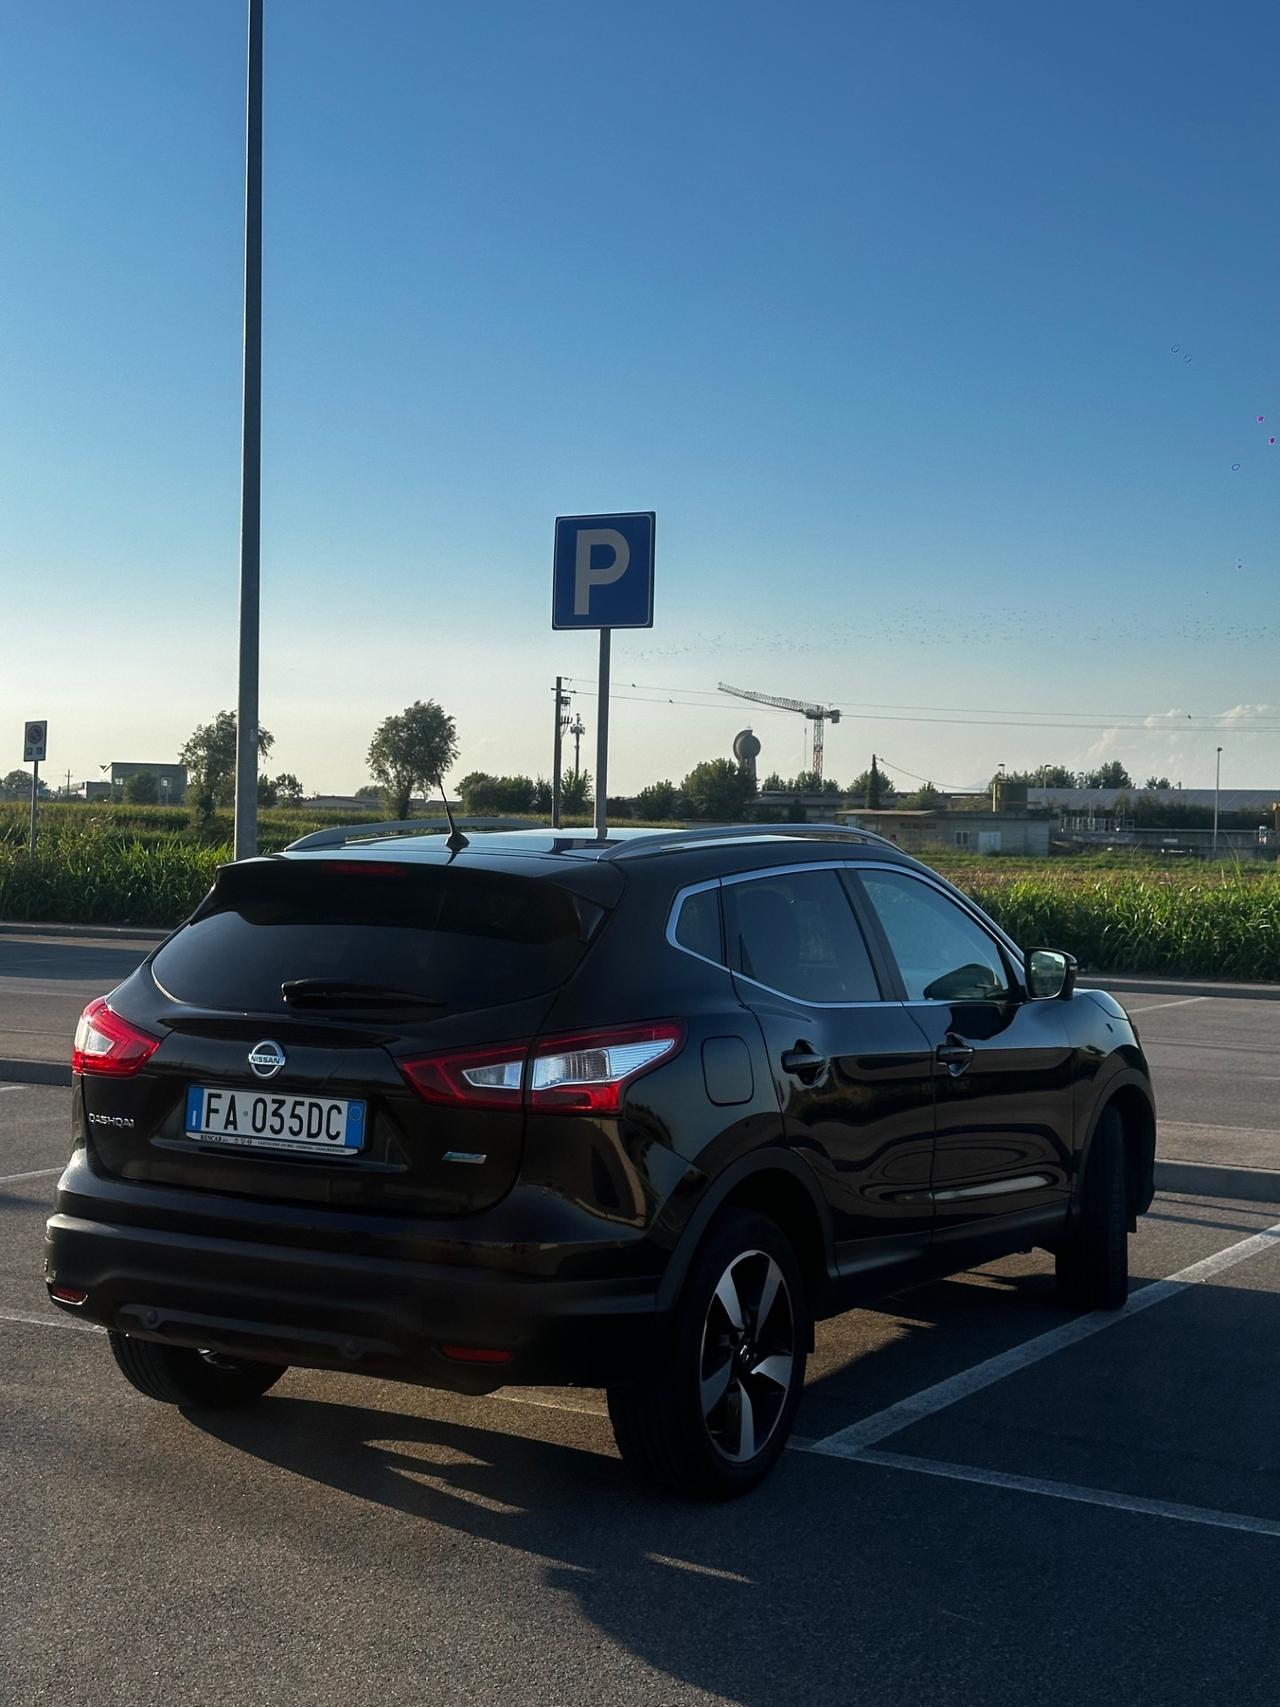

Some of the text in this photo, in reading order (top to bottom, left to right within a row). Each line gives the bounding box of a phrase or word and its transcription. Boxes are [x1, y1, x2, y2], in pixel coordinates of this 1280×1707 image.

[574, 528, 630, 615] P
[251, 1055, 280, 1064] NISSAN
[205, 1093, 343, 1141] FA 035DC
